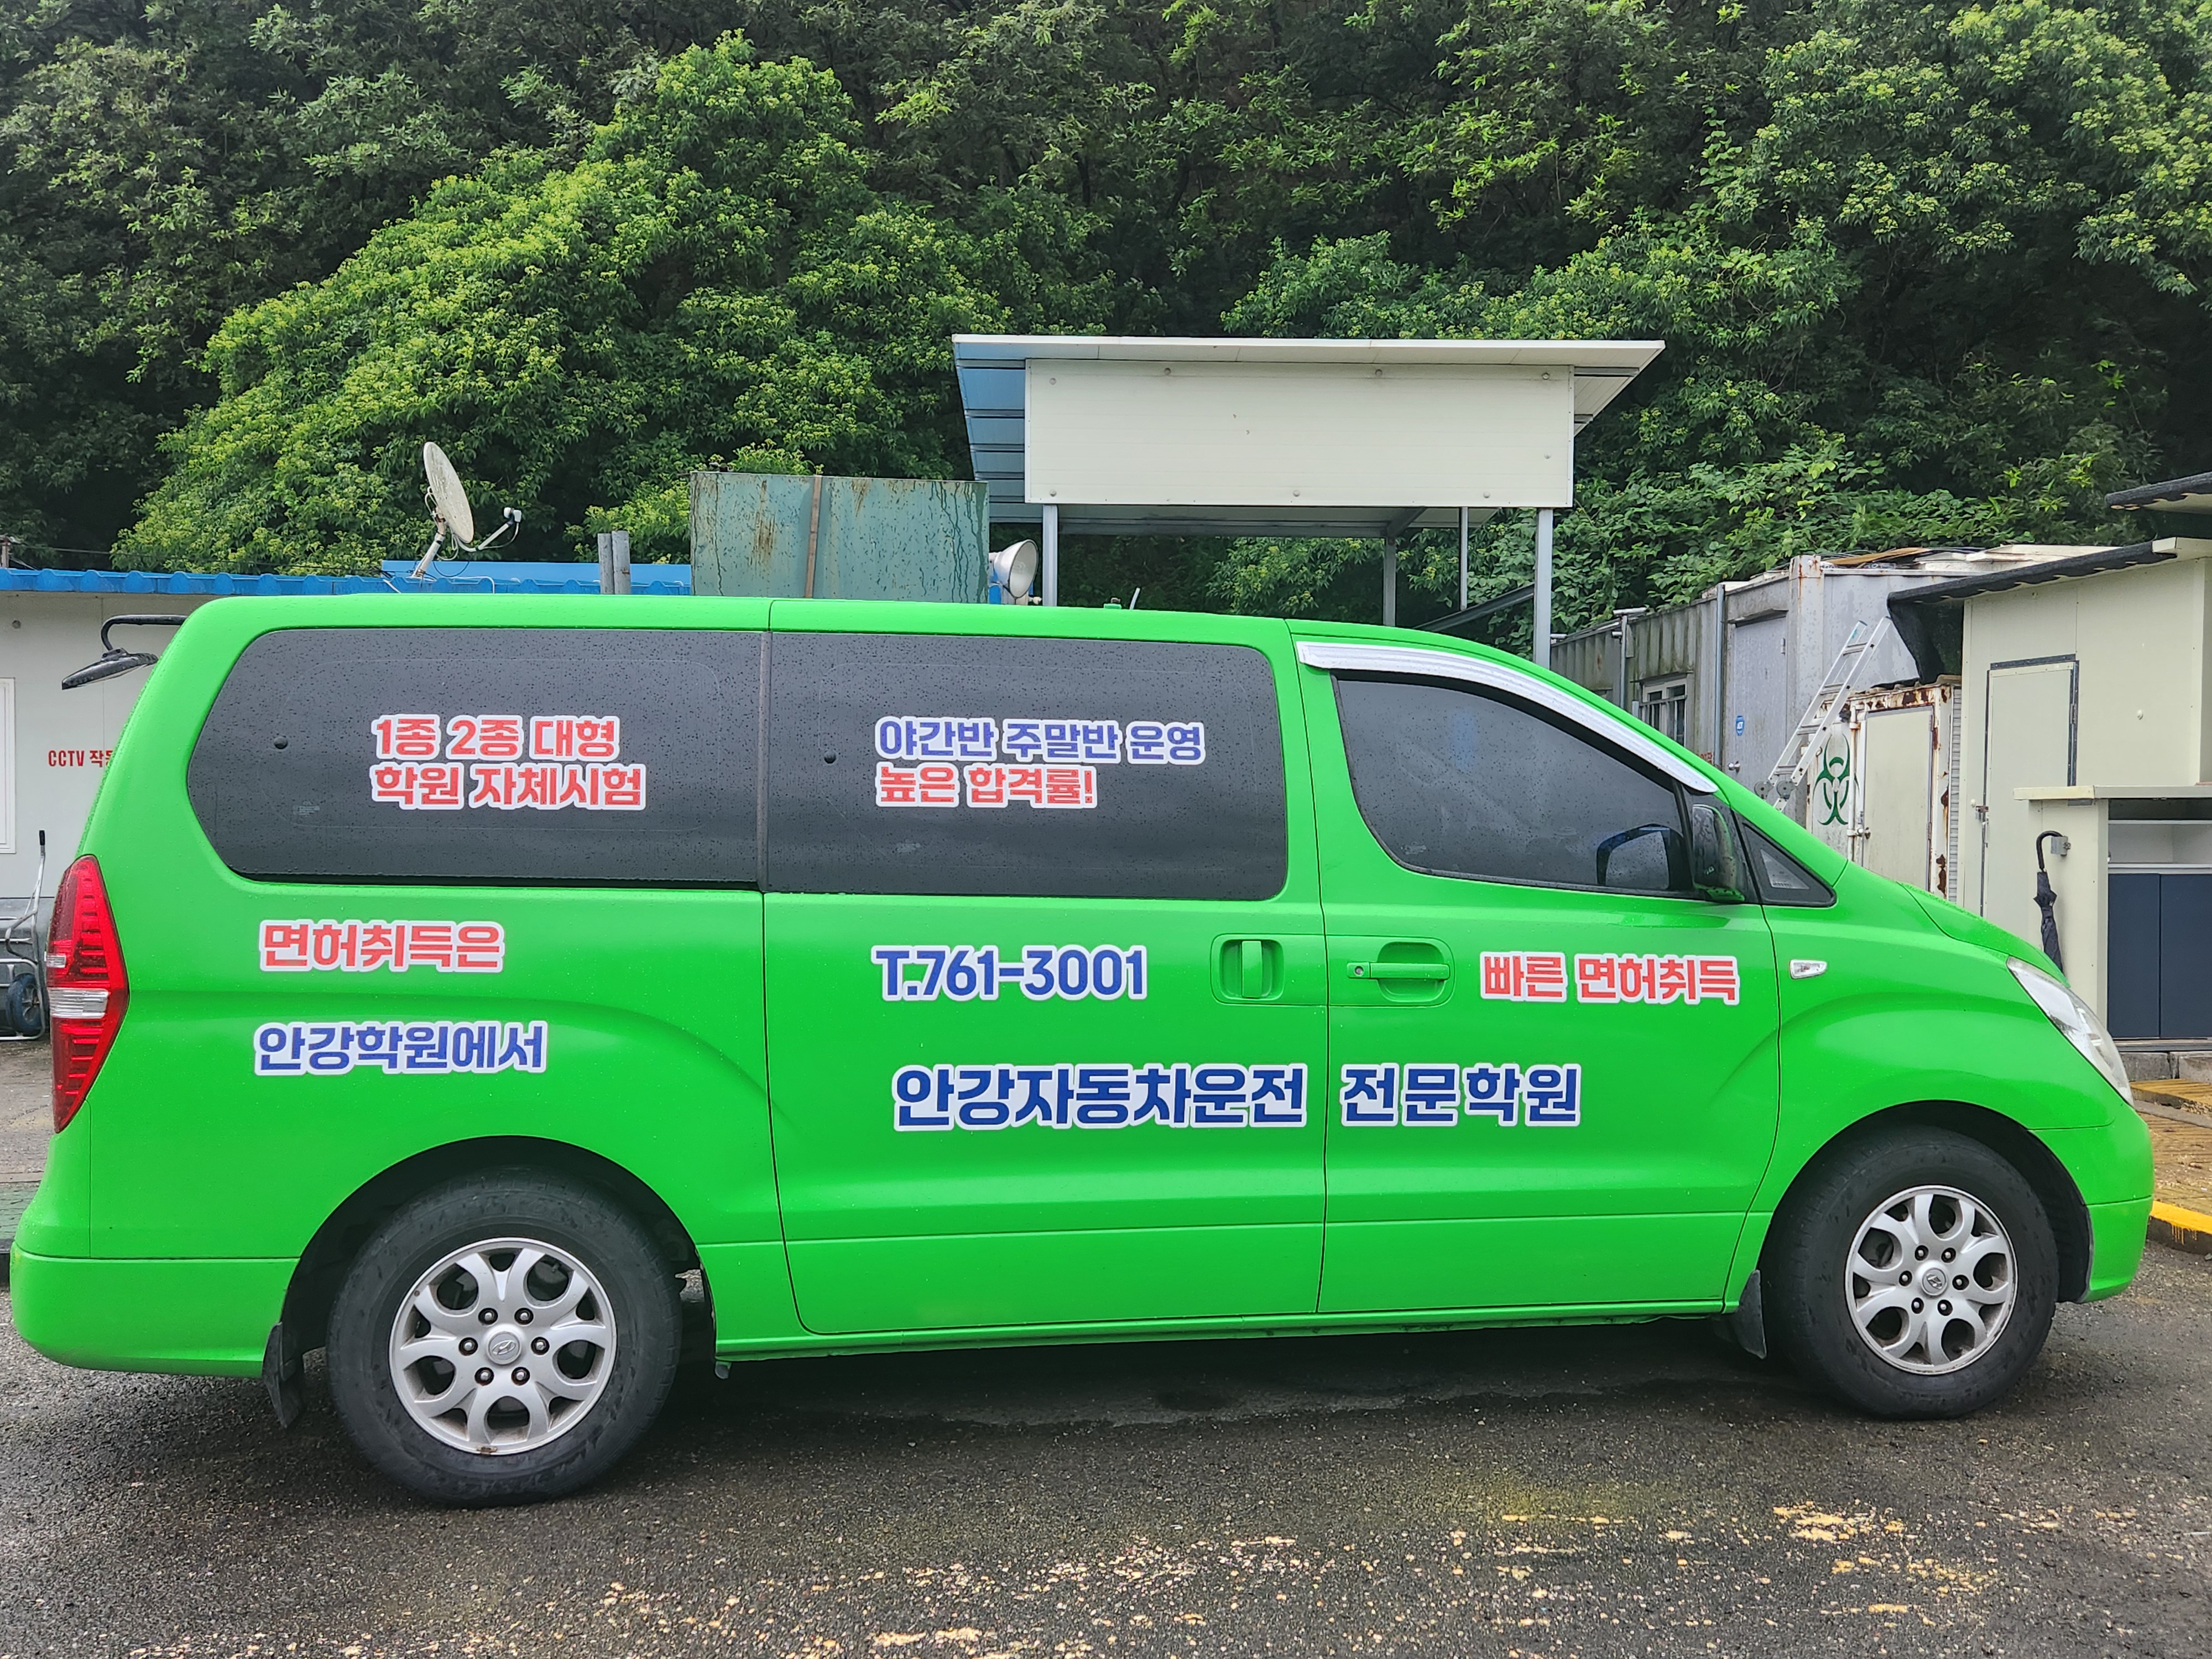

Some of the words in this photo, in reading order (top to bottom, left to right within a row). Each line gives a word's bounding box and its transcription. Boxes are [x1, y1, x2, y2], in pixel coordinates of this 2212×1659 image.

[48, 750, 85, 767] CCTV
[376, 717, 437, 757] 1종
[451, 718, 520, 757] 2종
[534, 719, 615, 758] 대형
[879, 719, 996, 758] 야간반
[1006, 722, 1120, 760] 주말반
[1129, 724, 1203, 761] 운영
[374, 765, 460, 806] 학원
[473, 766, 641, 807] 자체시험
[879, 765, 957, 804] 높은
[968, 766, 1094, 805] 합격률!
[263, 924, 502, 969] 면허취득은
[873, 949, 1144, 998] T.761-3001
[1483, 955, 1564, 999] 빠른
[1578, 957, 1737, 1001] 면허취득
[258, 1025, 544, 1072] 안강학원에서
[896, 1067, 1303, 1127] 안강자동차운전
[1343, 1067, 1578, 1123] 전문학원
